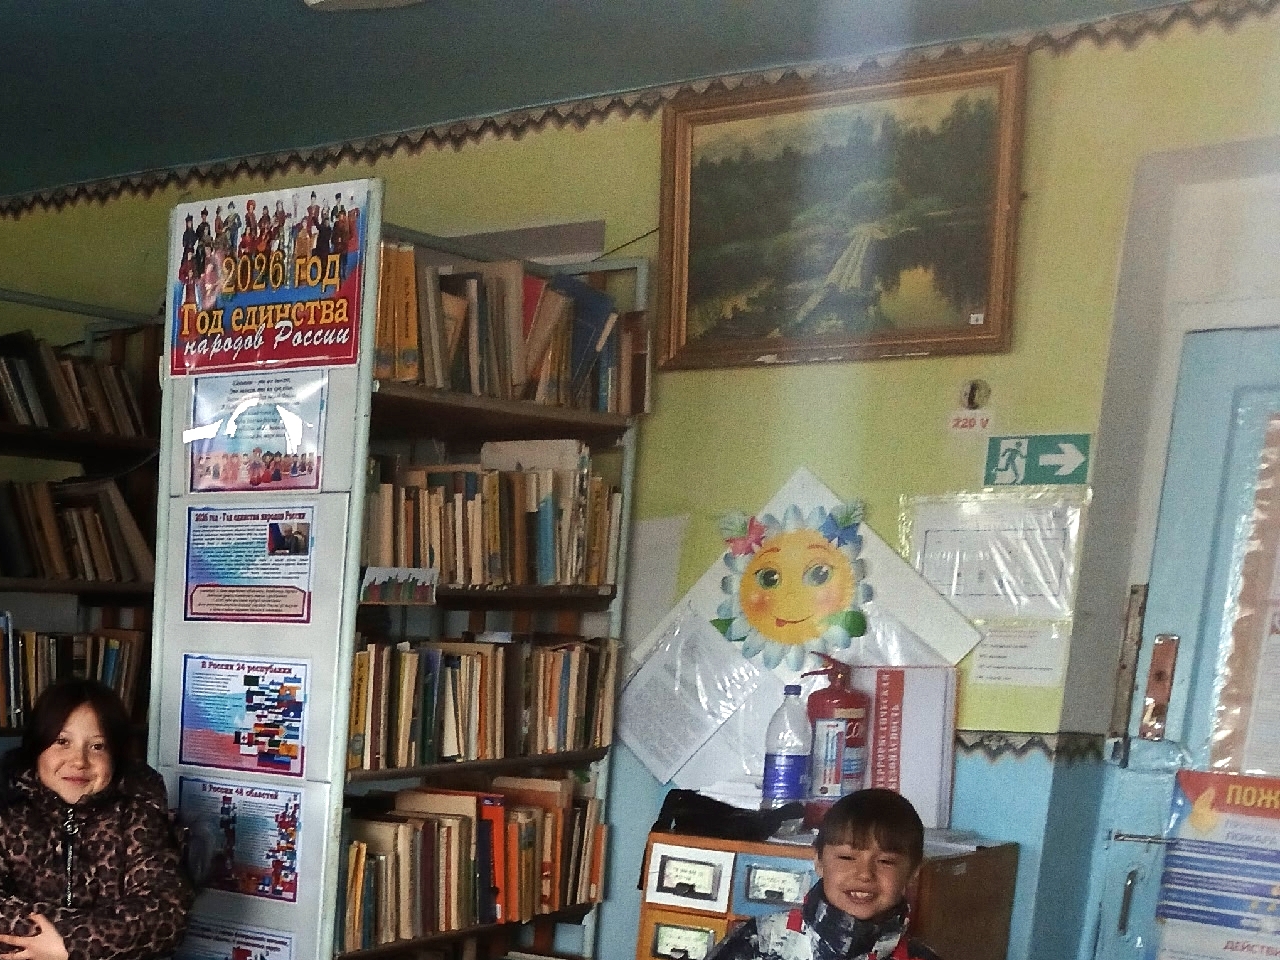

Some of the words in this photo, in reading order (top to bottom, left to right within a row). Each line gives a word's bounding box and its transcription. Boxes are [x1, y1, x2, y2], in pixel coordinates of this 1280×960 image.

[222, 249, 284, 294] 2026
[294, 252, 341, 292] год
[180, 303, 224, 336] Год
[231, 297, 349, 334] единства
[183, 323, 265, 360] народов
[273, 320, 350, 350] России
[952, 417, 976, 429] 220
